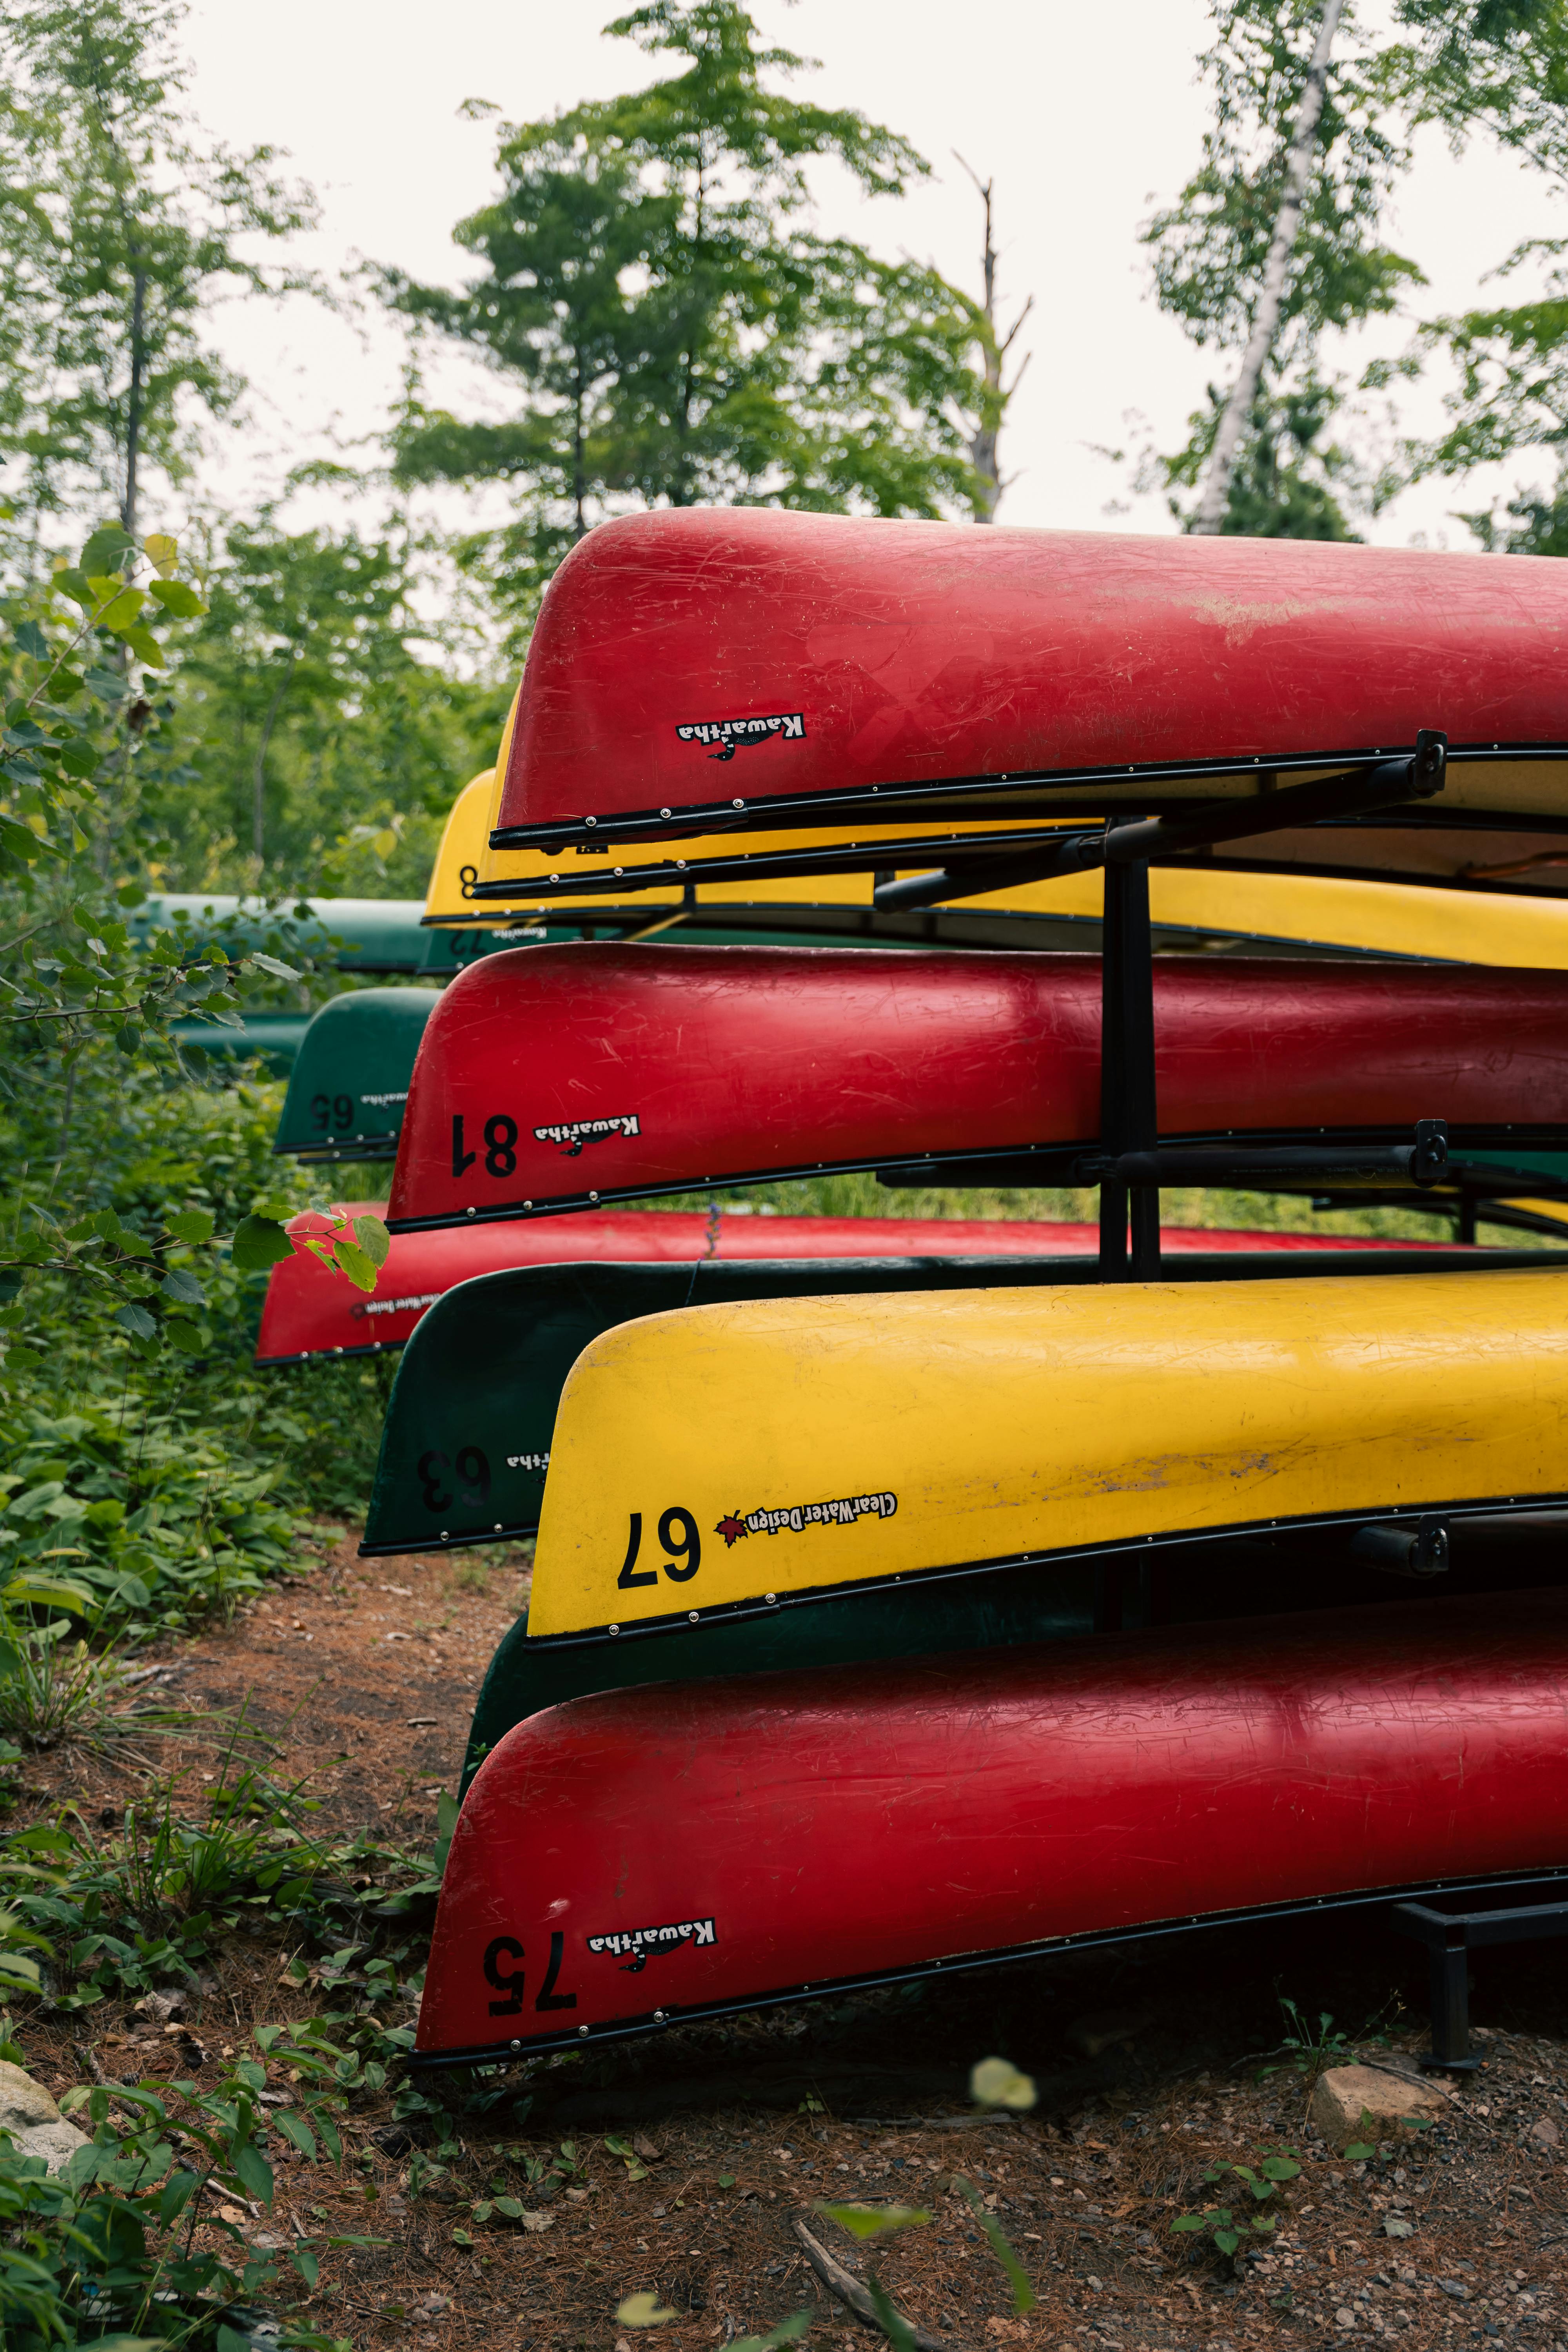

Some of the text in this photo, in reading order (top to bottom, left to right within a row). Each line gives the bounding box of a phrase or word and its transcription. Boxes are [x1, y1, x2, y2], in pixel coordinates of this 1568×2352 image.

[678, 715, 803, 743] Kawartha
[450, 928, 485, 956] 72
[311, 1094, 354, 1130] 65
[535, 1116, 639, 1142] Kawartha
[452, 1114, 518, 1177] 81
[507, 1453, 550, 1470] rtha
[417, 1446, 492, 1513] 63
[748, 1509, 803, 1533] Design
[617, 1506, 701, 1590] 67
[589, 1920, 715, 1955] Kawartha
[483, 1932, 577, 2017] 75
